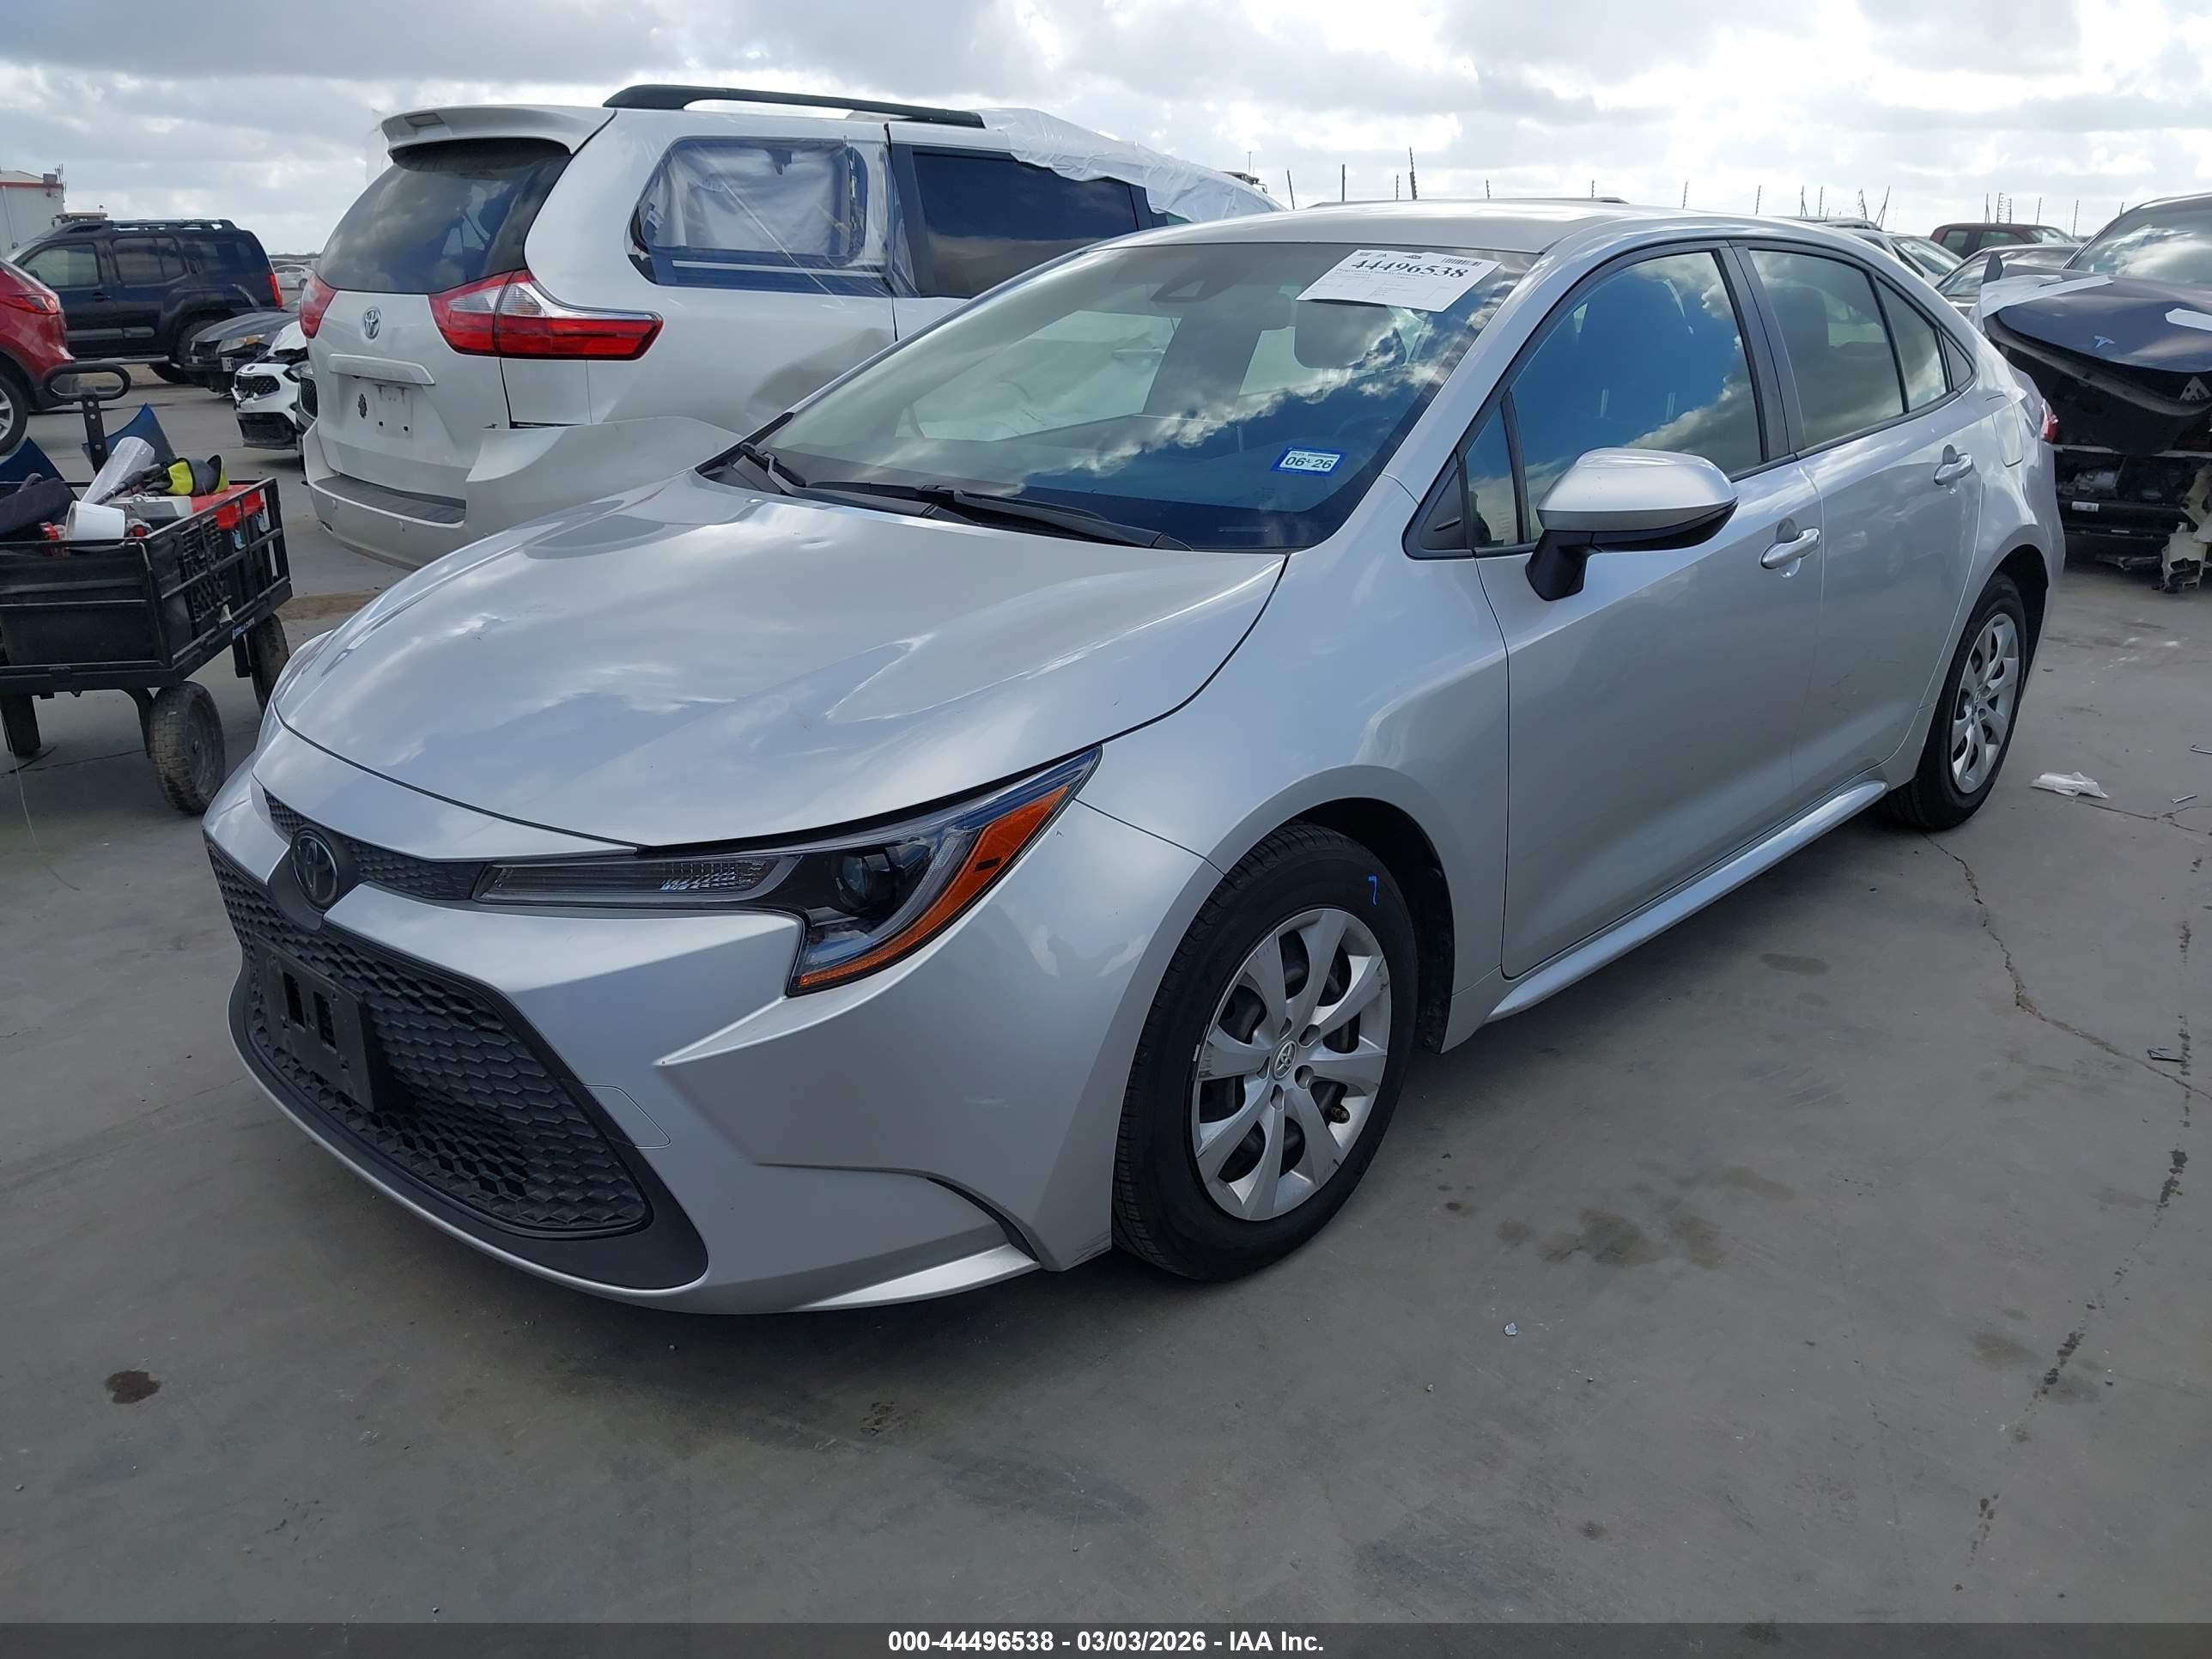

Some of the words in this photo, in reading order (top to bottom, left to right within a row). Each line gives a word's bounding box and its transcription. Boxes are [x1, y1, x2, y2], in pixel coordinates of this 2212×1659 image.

[1351, 259, 1468, 277] 44496538
[1285, 456, 1306, 466] 06
[1311, 459, 1334, 469] 26
